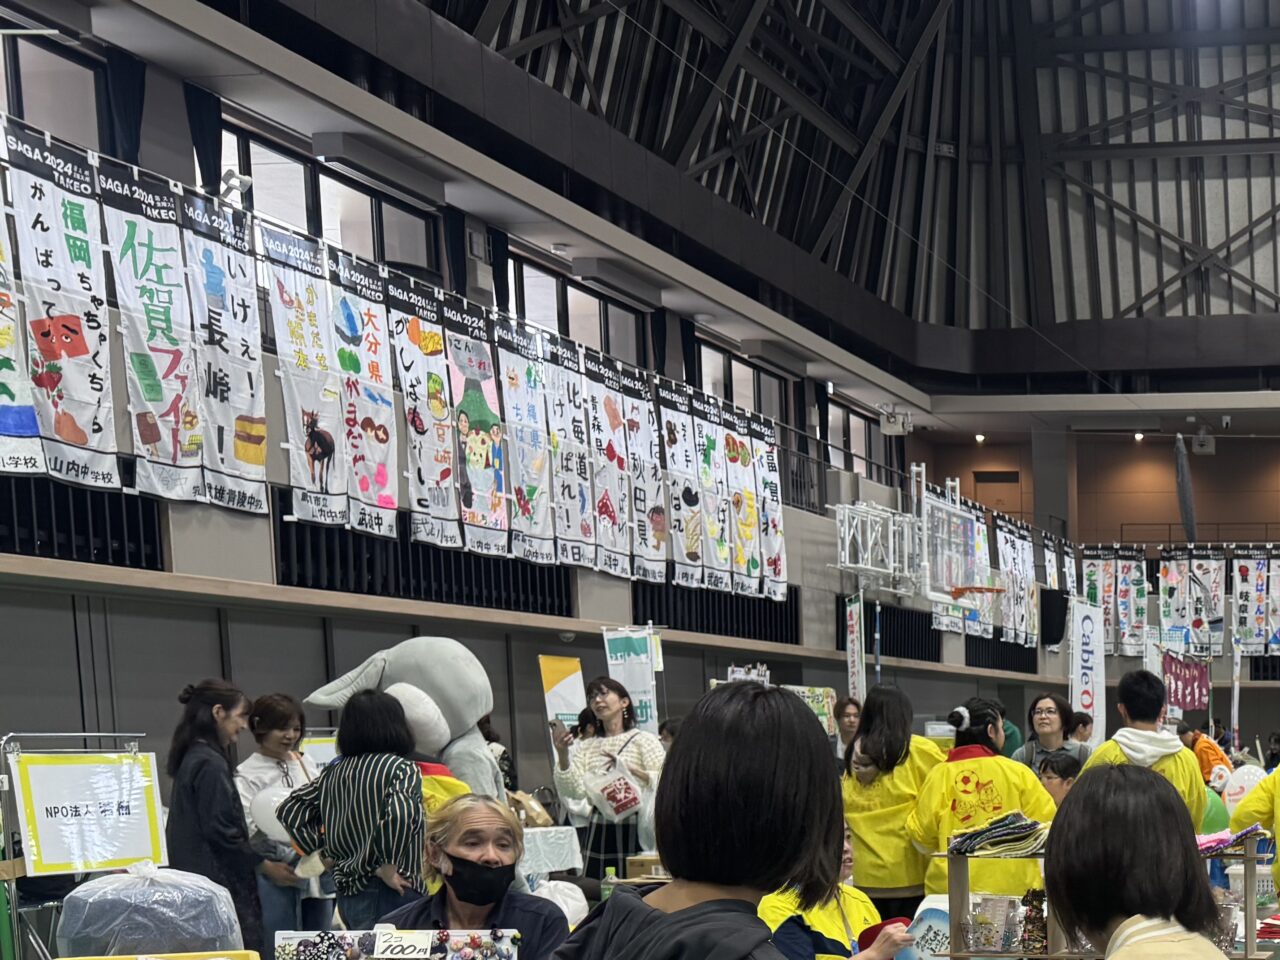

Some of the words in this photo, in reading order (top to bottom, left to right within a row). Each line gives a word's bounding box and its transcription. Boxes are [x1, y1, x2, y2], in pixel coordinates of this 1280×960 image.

[7, 136, 43, 162] SAGA
[44, 152, 72, 176] 2024
[53, 171, 92, 195] TAKEO
[100, 175, 130, 197] SAGA
[132, 187, 155, 206] 2024
[141, 204, 176, 220] TAKEO
[212, 216, 234, 236] 2024
[220, 234, 249, 250] TAKEO
[351, 271, 368, 286] 2024
[357, 285, 384, 300] TAKEO
[388, 285, 408, 302] SAGA
[416, 307, 437, 321] TAKEO
[363, 308, 382, 383] 大分県
[1081, 614, 1094, 686] Cable
[381, 944, 428, 956] 100円
